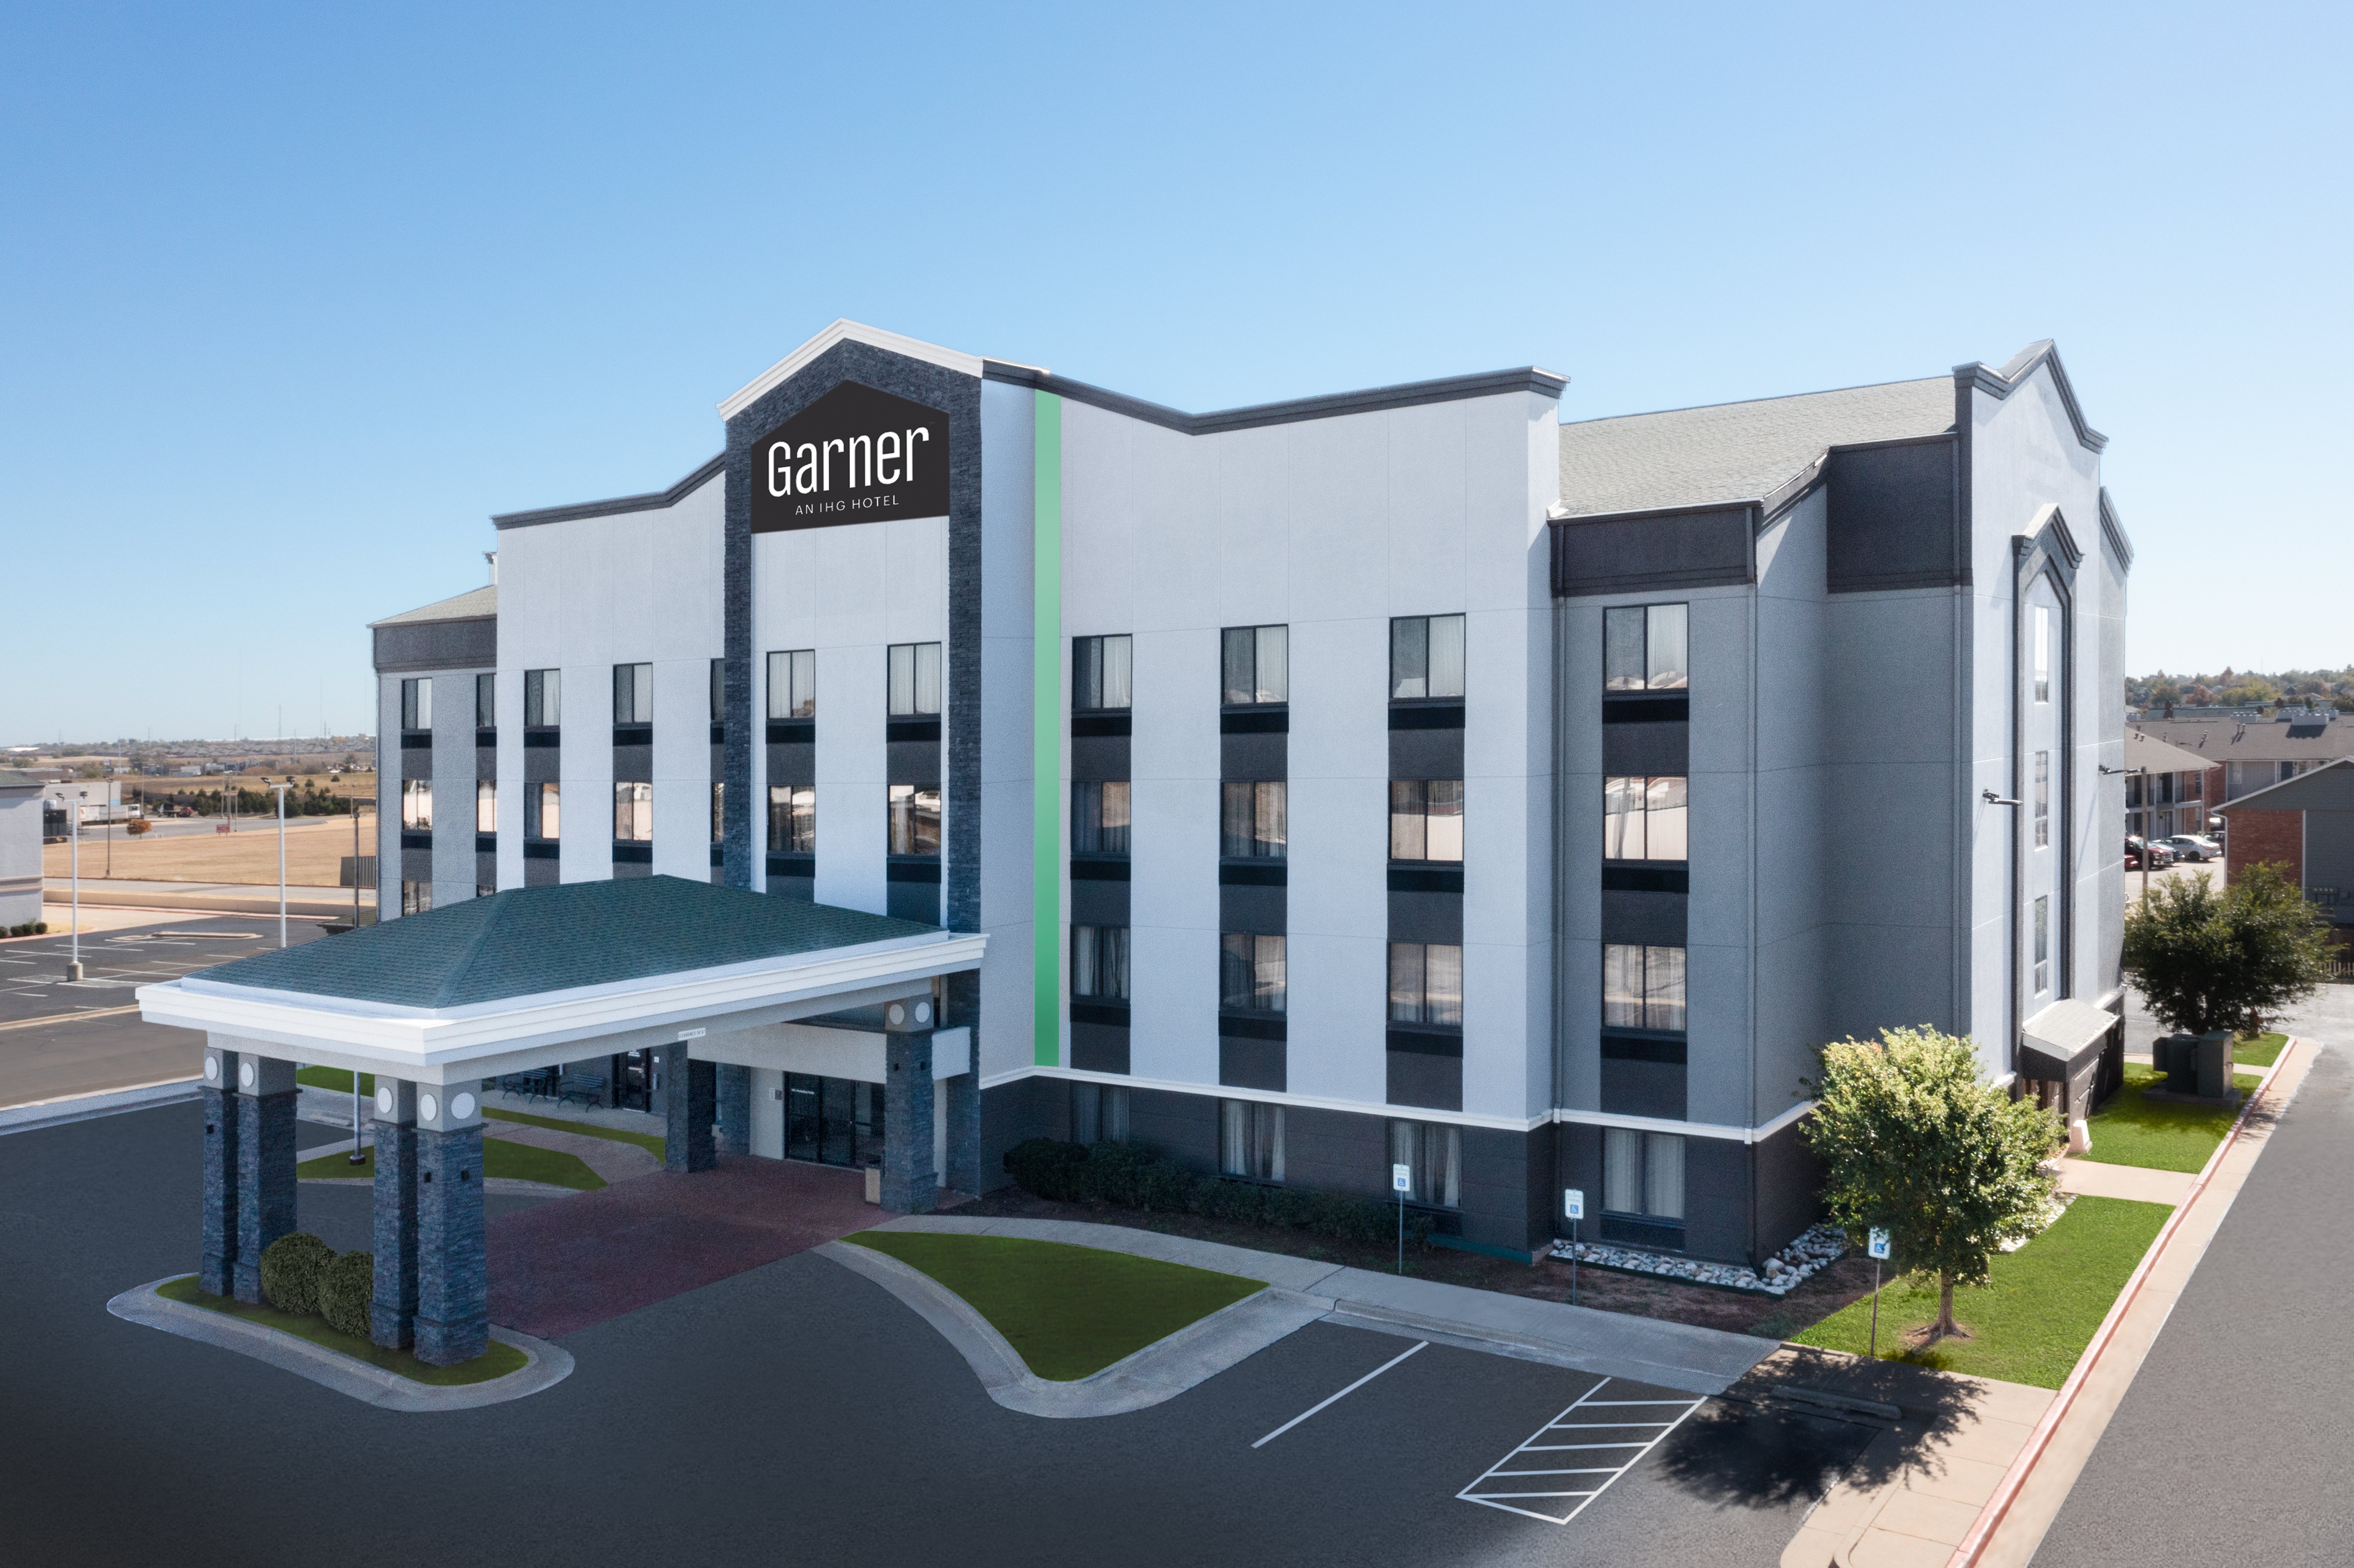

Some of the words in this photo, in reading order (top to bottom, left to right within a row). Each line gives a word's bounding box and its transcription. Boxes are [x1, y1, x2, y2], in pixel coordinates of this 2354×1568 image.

[768, 427, 929, 497] Garner
[796, 504, 813, 515] AN
[820, 501, 845, 512] IHG
[853, 495, 898, 509] HOTEL
